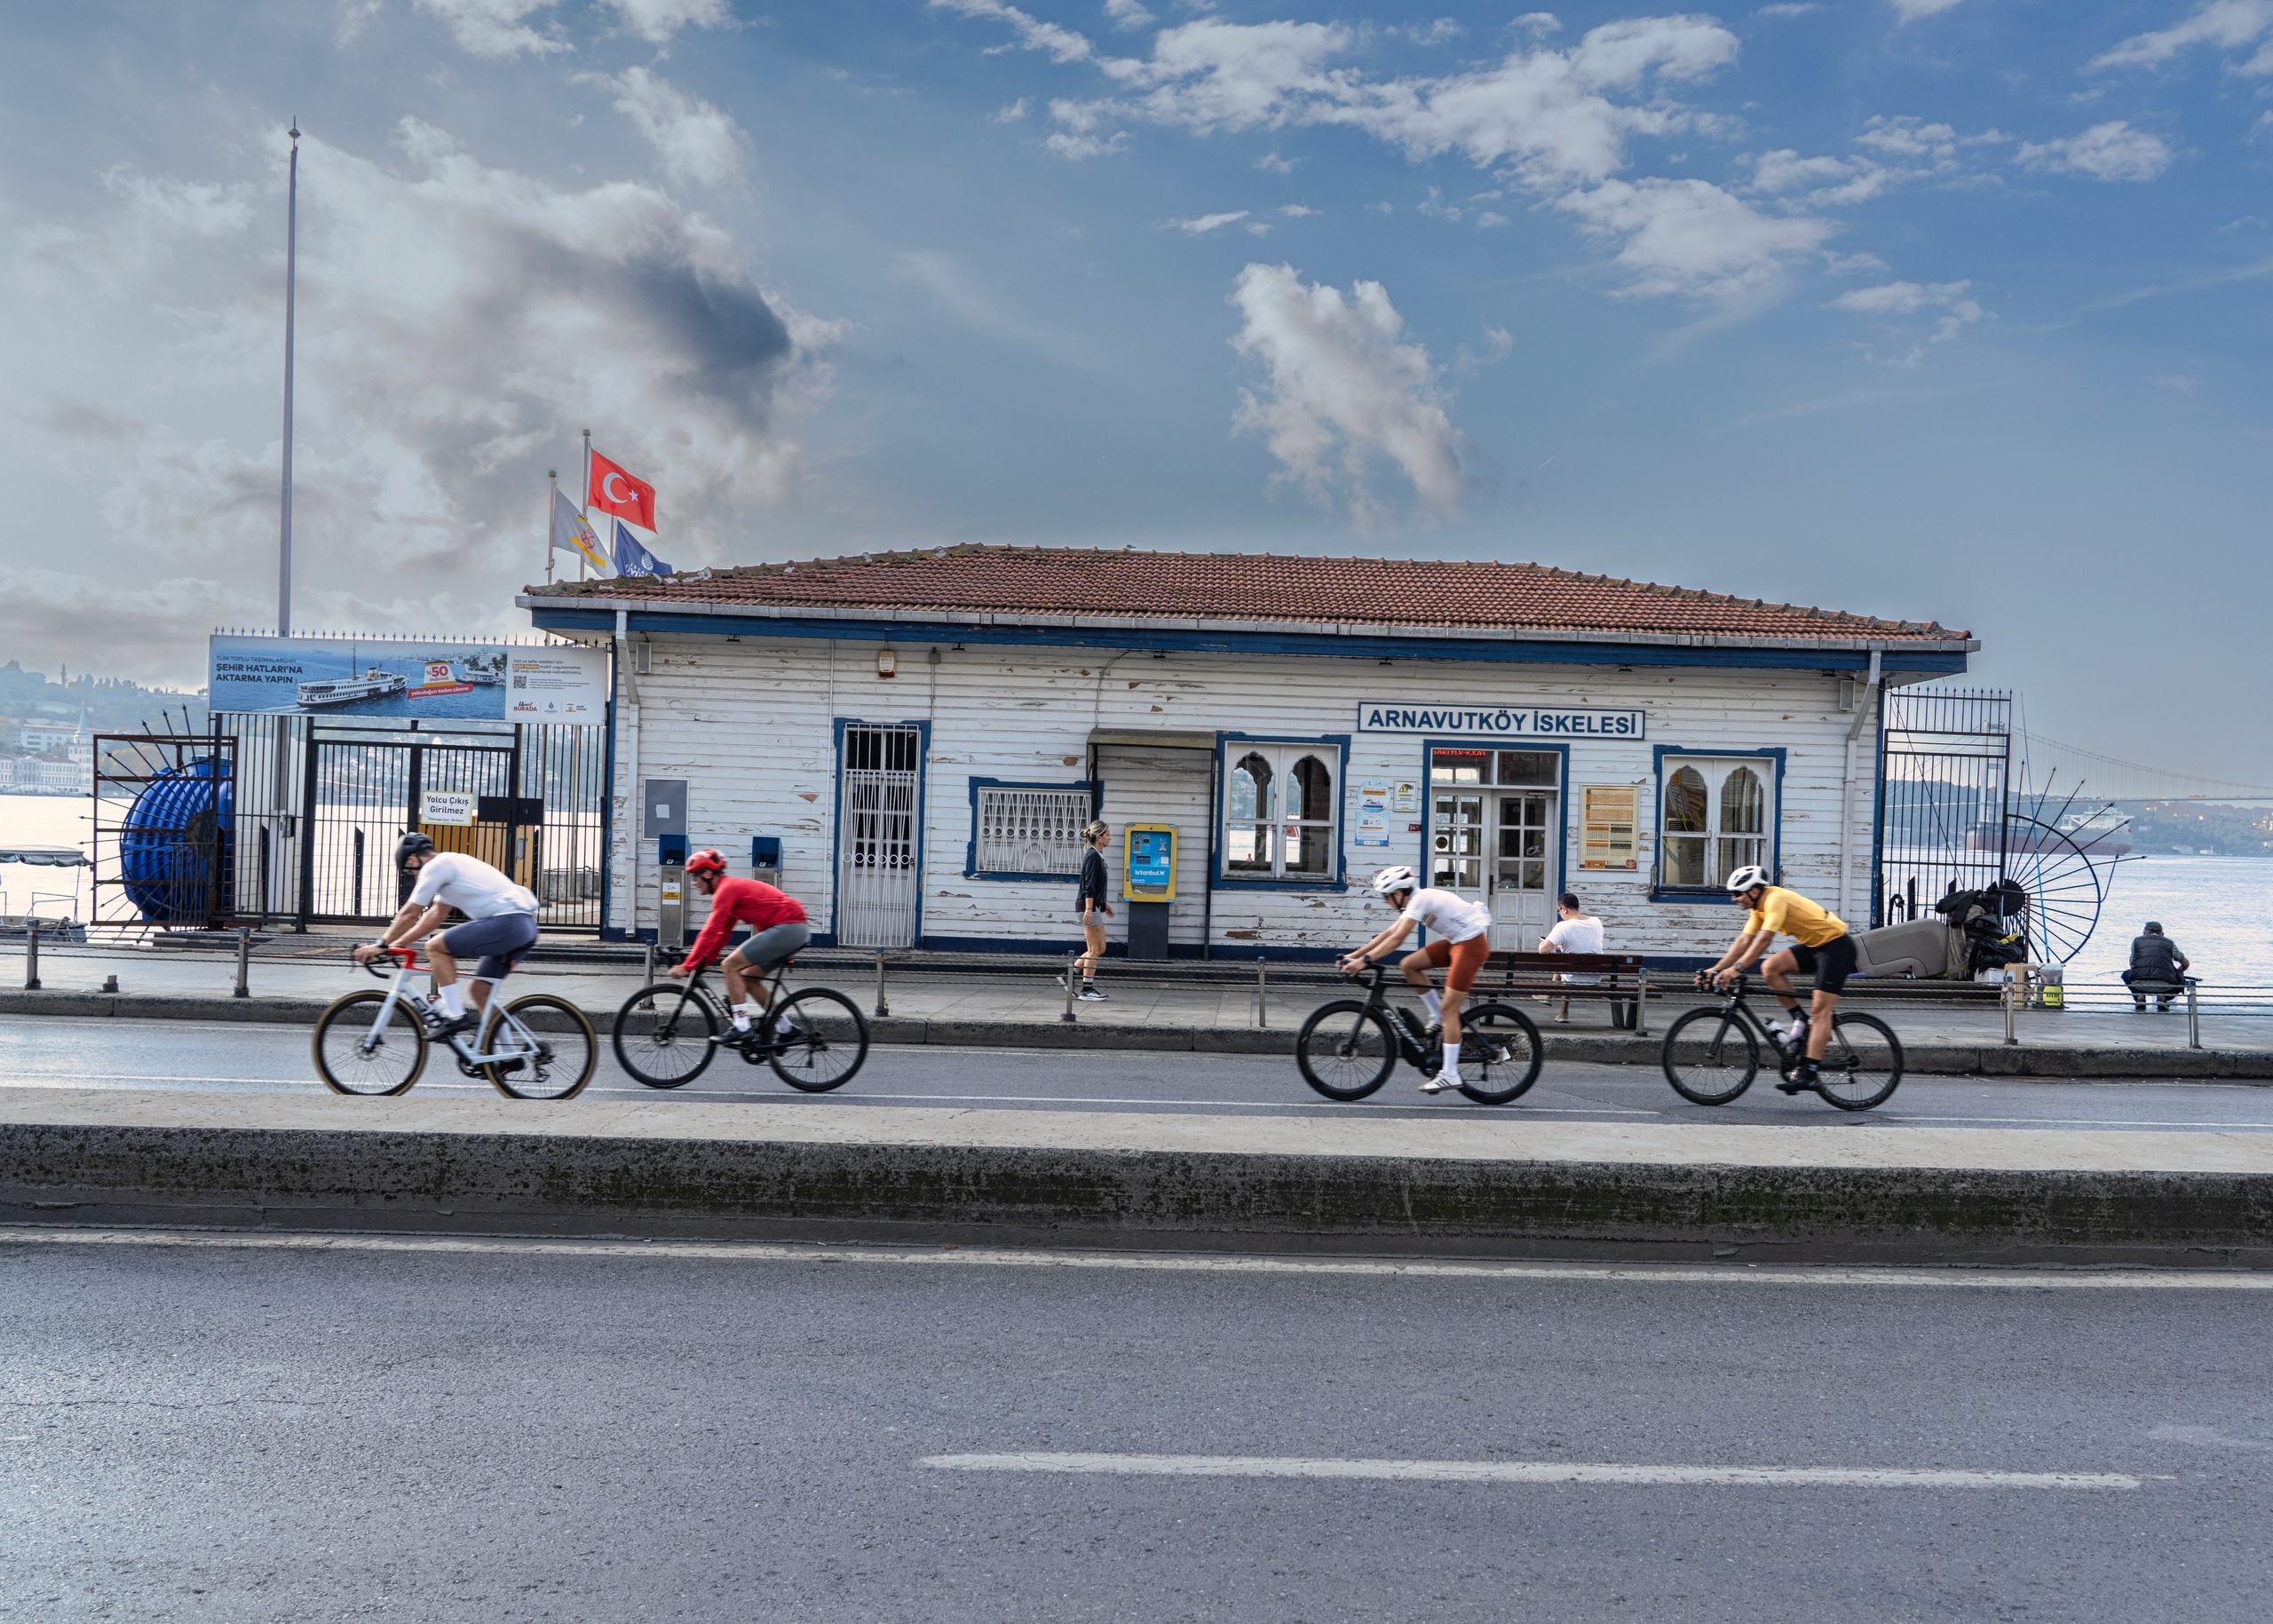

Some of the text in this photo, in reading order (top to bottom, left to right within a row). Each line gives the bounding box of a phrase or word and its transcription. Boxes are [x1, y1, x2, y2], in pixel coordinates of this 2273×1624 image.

[216, 663, 303, 674] ŞEHİR HATLARI'NA
[426, 665, 448, 677] %50
[216, 673, 293, 684] AKTARMA YAPIN
[410, 688, 438, 697] yolculuğun
[1367, 709, 1636, 734] ARNAVUTKÖY İSKELESİ
[426, 795, 469, 806] Yolcu Çıkış
[430, 805, 463, 814] Girilmez
